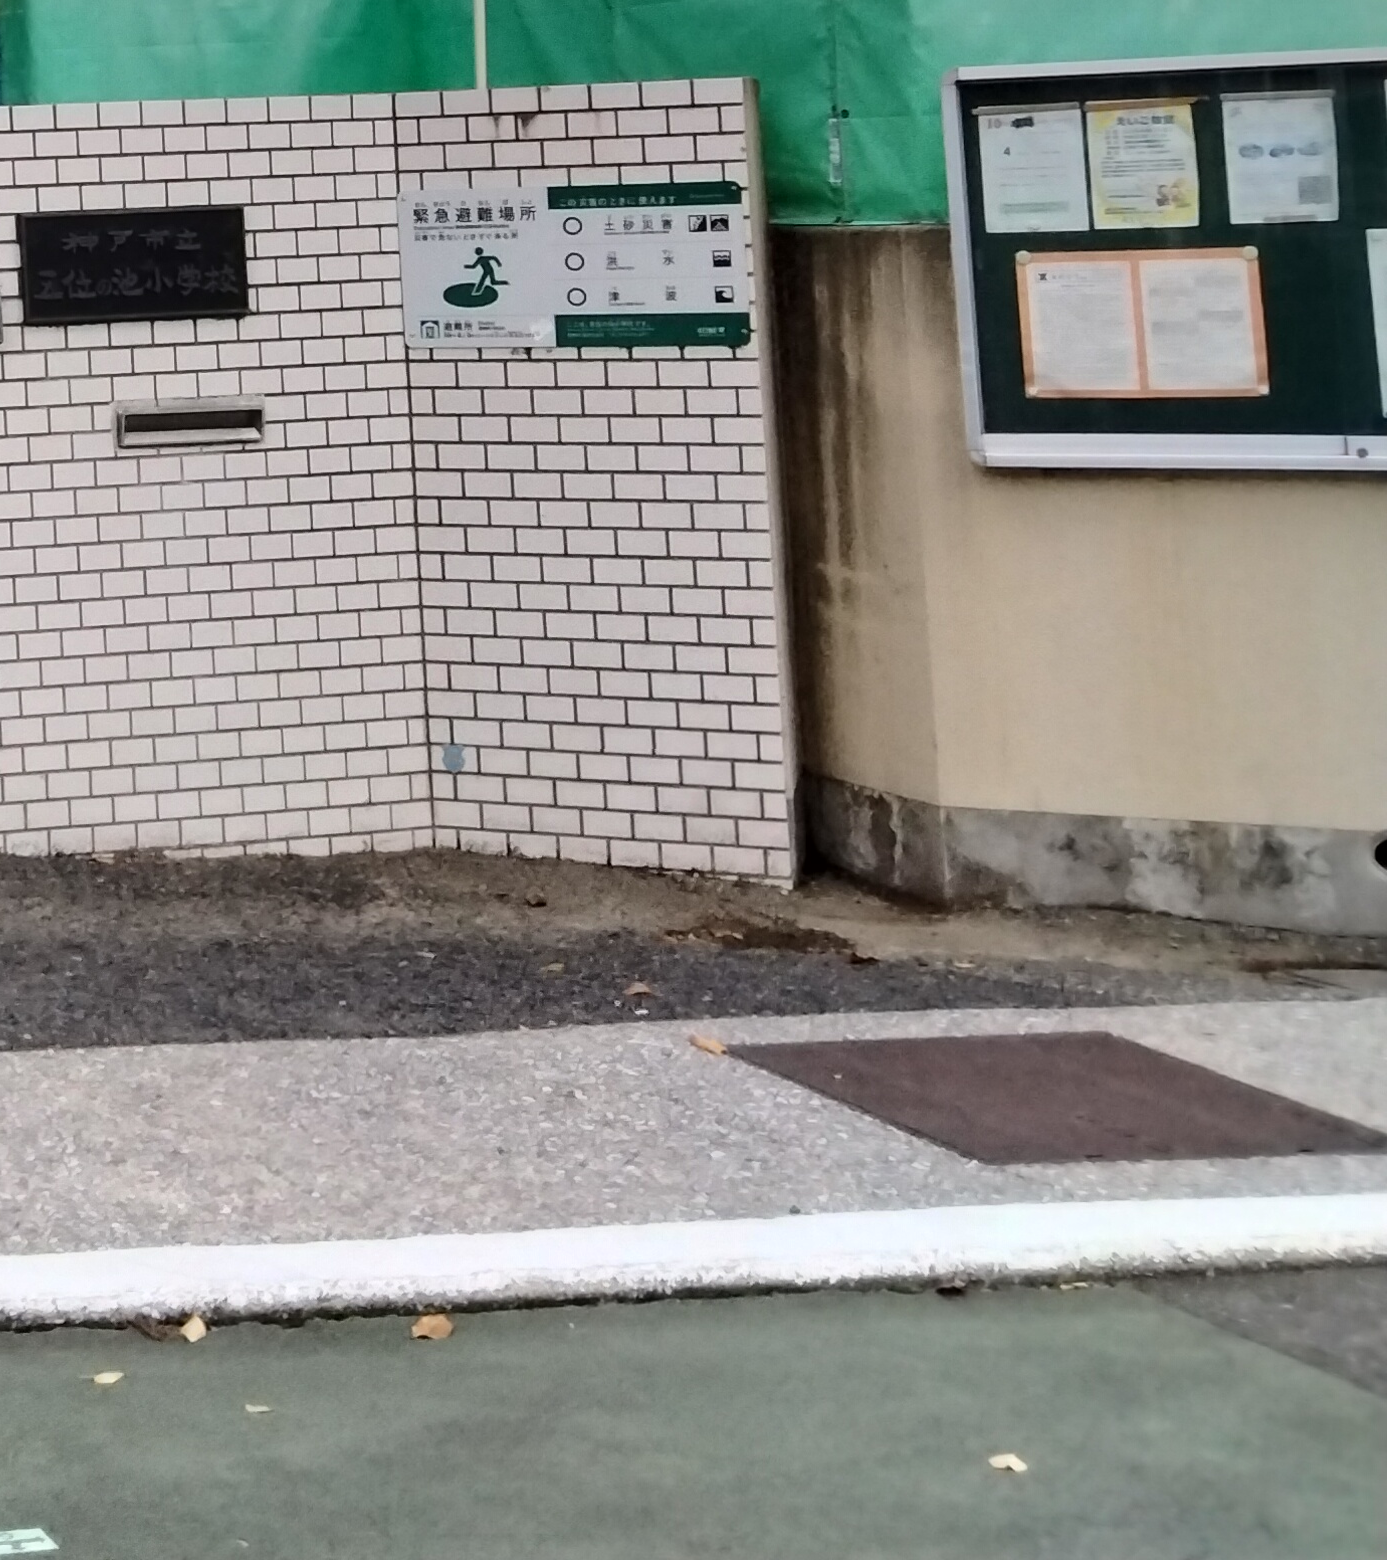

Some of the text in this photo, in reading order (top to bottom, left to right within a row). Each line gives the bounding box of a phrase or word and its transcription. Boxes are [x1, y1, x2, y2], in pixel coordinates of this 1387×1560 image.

[413, 207, 536, 223] 緊急避難場所
[34, 263, 238, 300] 五位の池小学校
